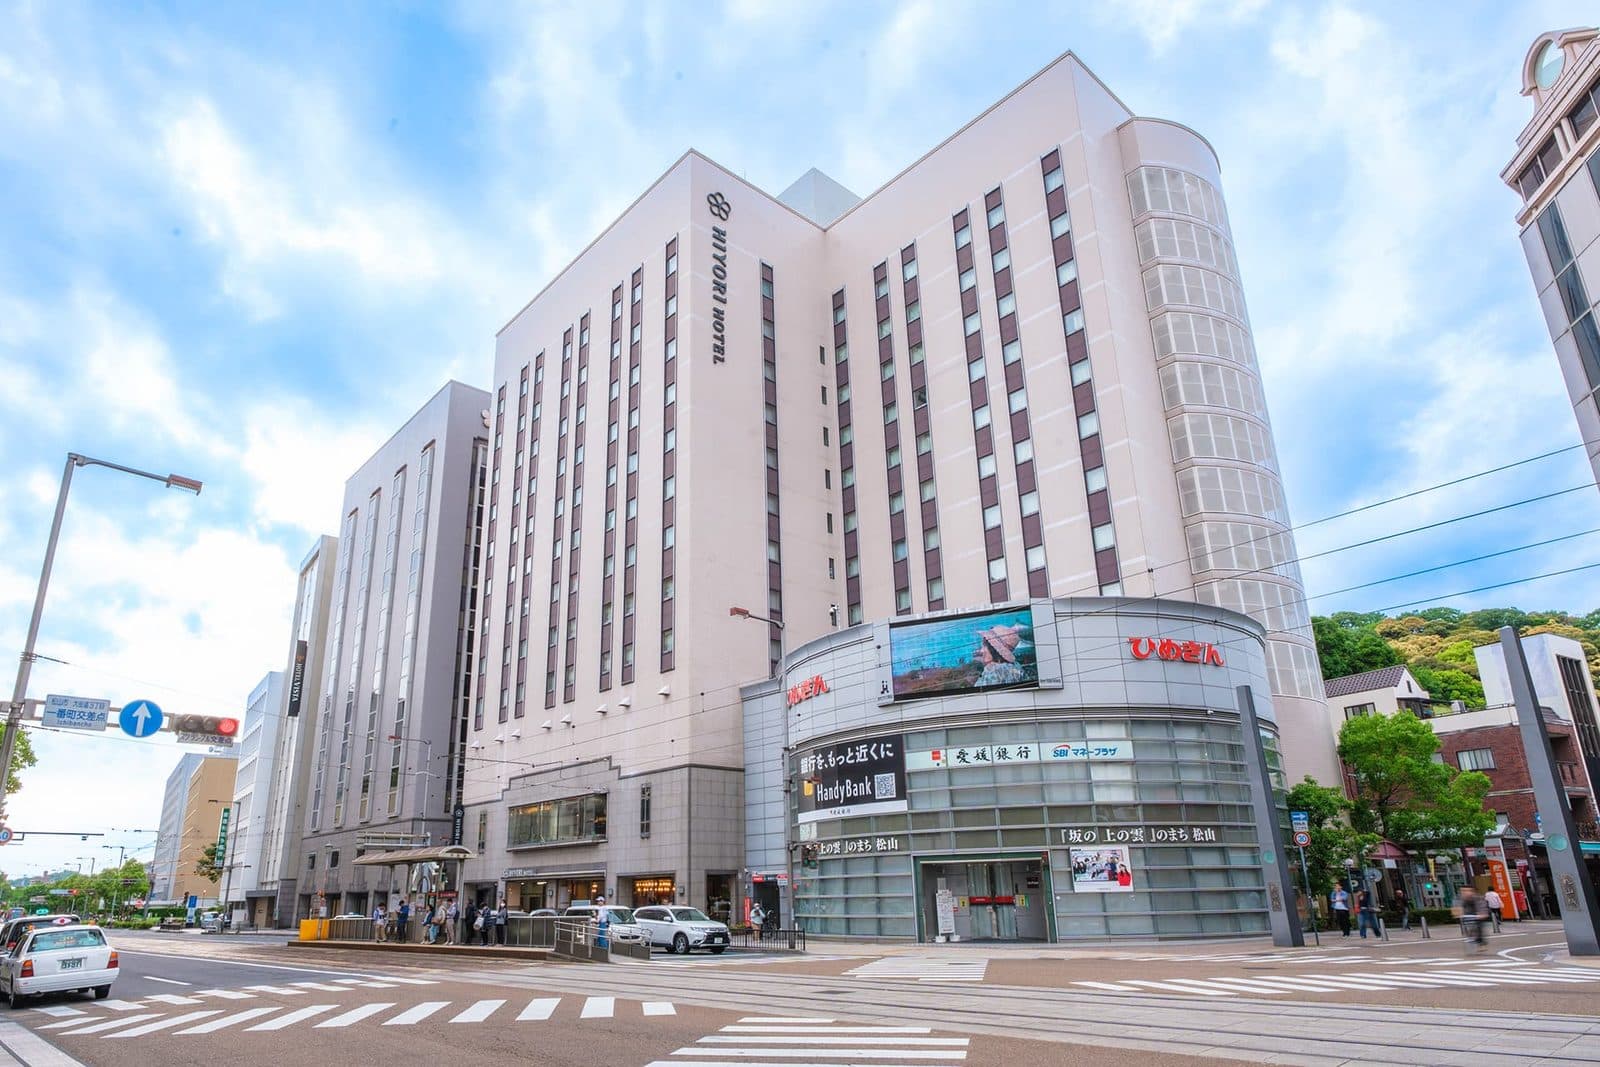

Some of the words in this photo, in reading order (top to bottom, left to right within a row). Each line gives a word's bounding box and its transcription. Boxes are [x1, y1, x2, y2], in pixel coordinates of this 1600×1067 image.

[712, 225, 727, 304] HIYORI
[712, 307, 725, 364] HOTEL
[1127, 637, 1224, 667] ひめぎん
[292, 681, 301, 702] VISTA
[46, 708, 106, 721] 一番町交差点
[800, 743, 894, 775] 銀行を、もっと近くに
[956, 745, 1031, 764] 愛媛銀行
[1053, 749, 1068, 758] SBI
[1072, 747, 1118, 757] マネープラザ
[817, 775, 872, 803] HandyBank
[876, 838, 898, 851] 松山
[1193, 827, 1216, 842] 松山
